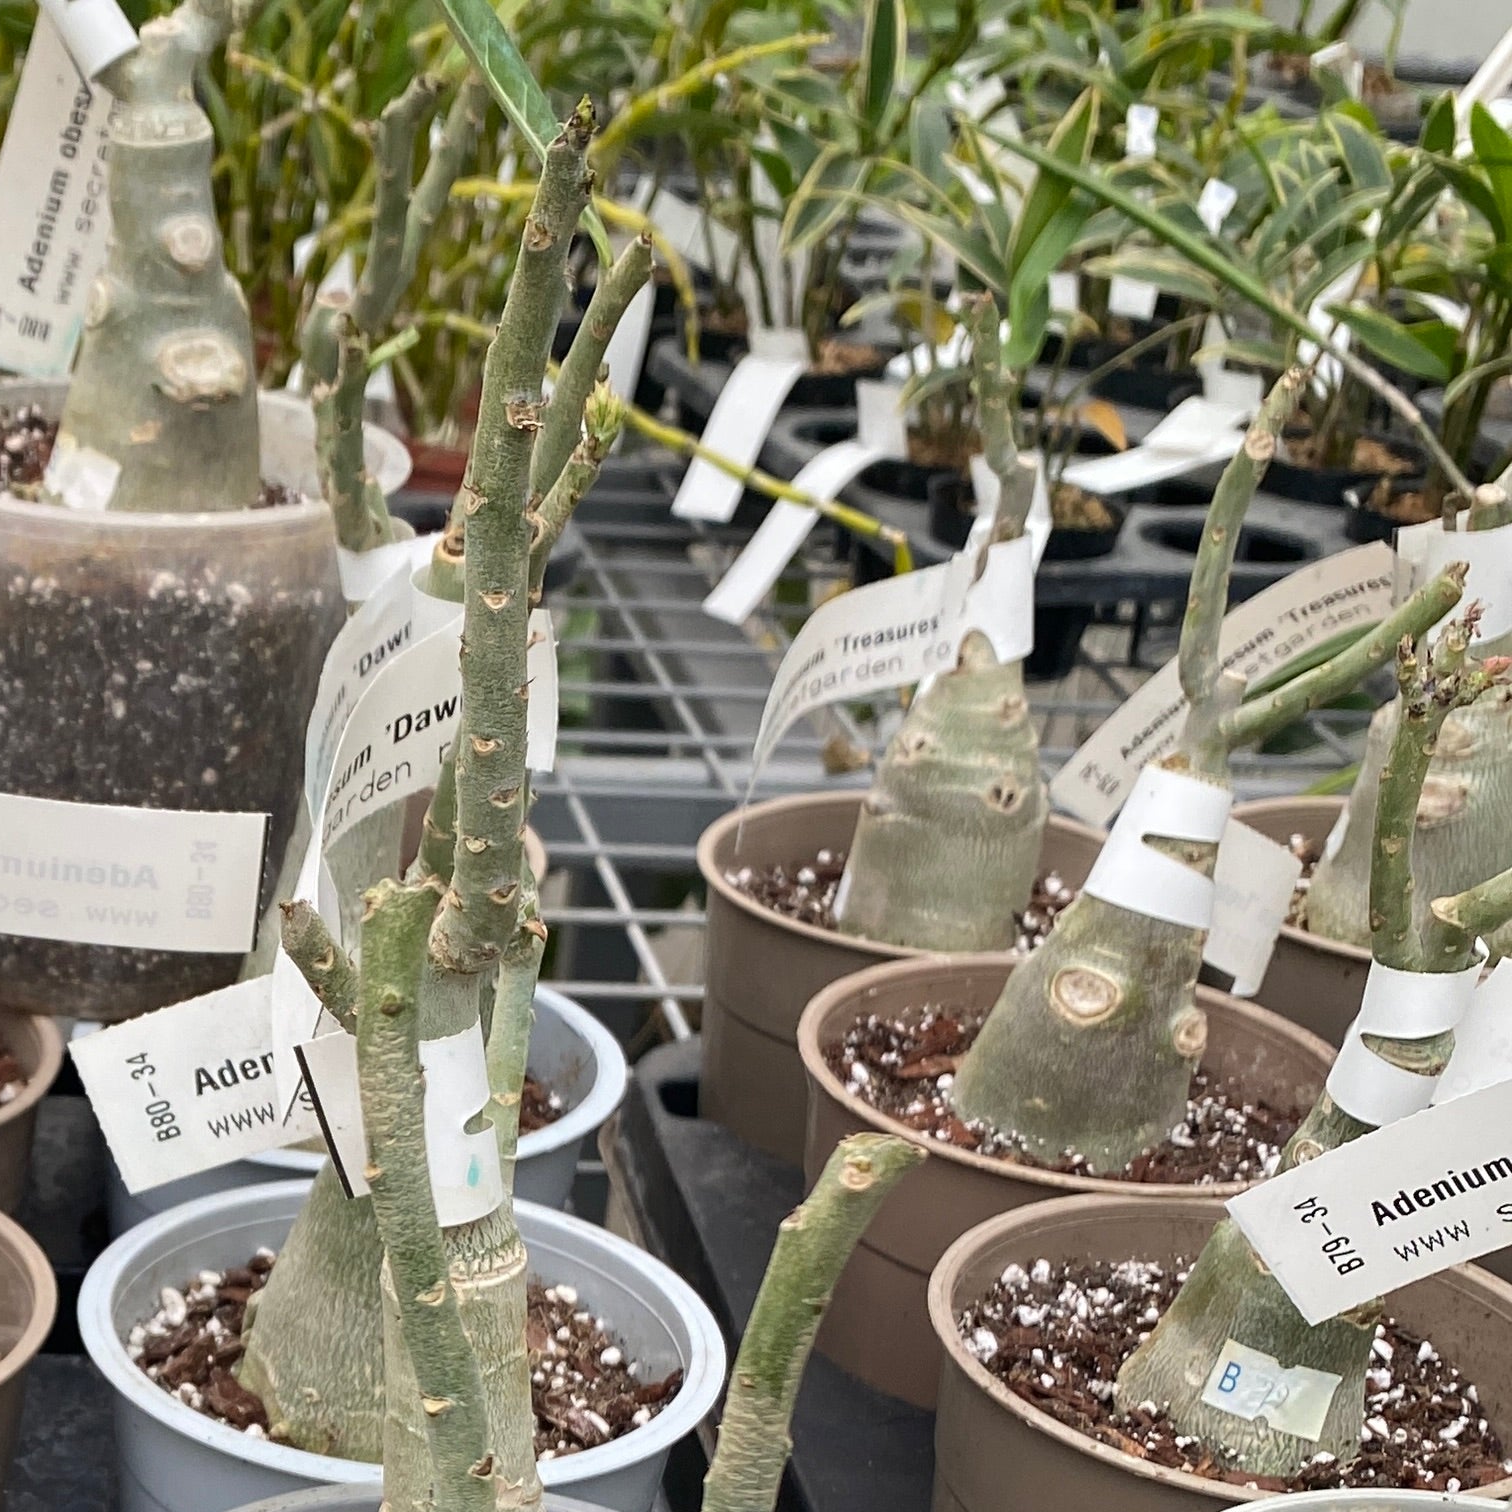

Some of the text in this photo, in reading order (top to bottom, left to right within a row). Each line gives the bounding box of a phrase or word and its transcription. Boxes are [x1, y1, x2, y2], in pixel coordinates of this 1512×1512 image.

[18, 169, 69, 294] Adenium
[386, 694, 463, 744] 'Daw
[125, 1051, 182, 1143] B80-34
[1370, 1157, 1512, 1227] Adenium
[1294, 1196, 1365, 1276] B79-34
[1217, 1360, 1241, 1393] B
